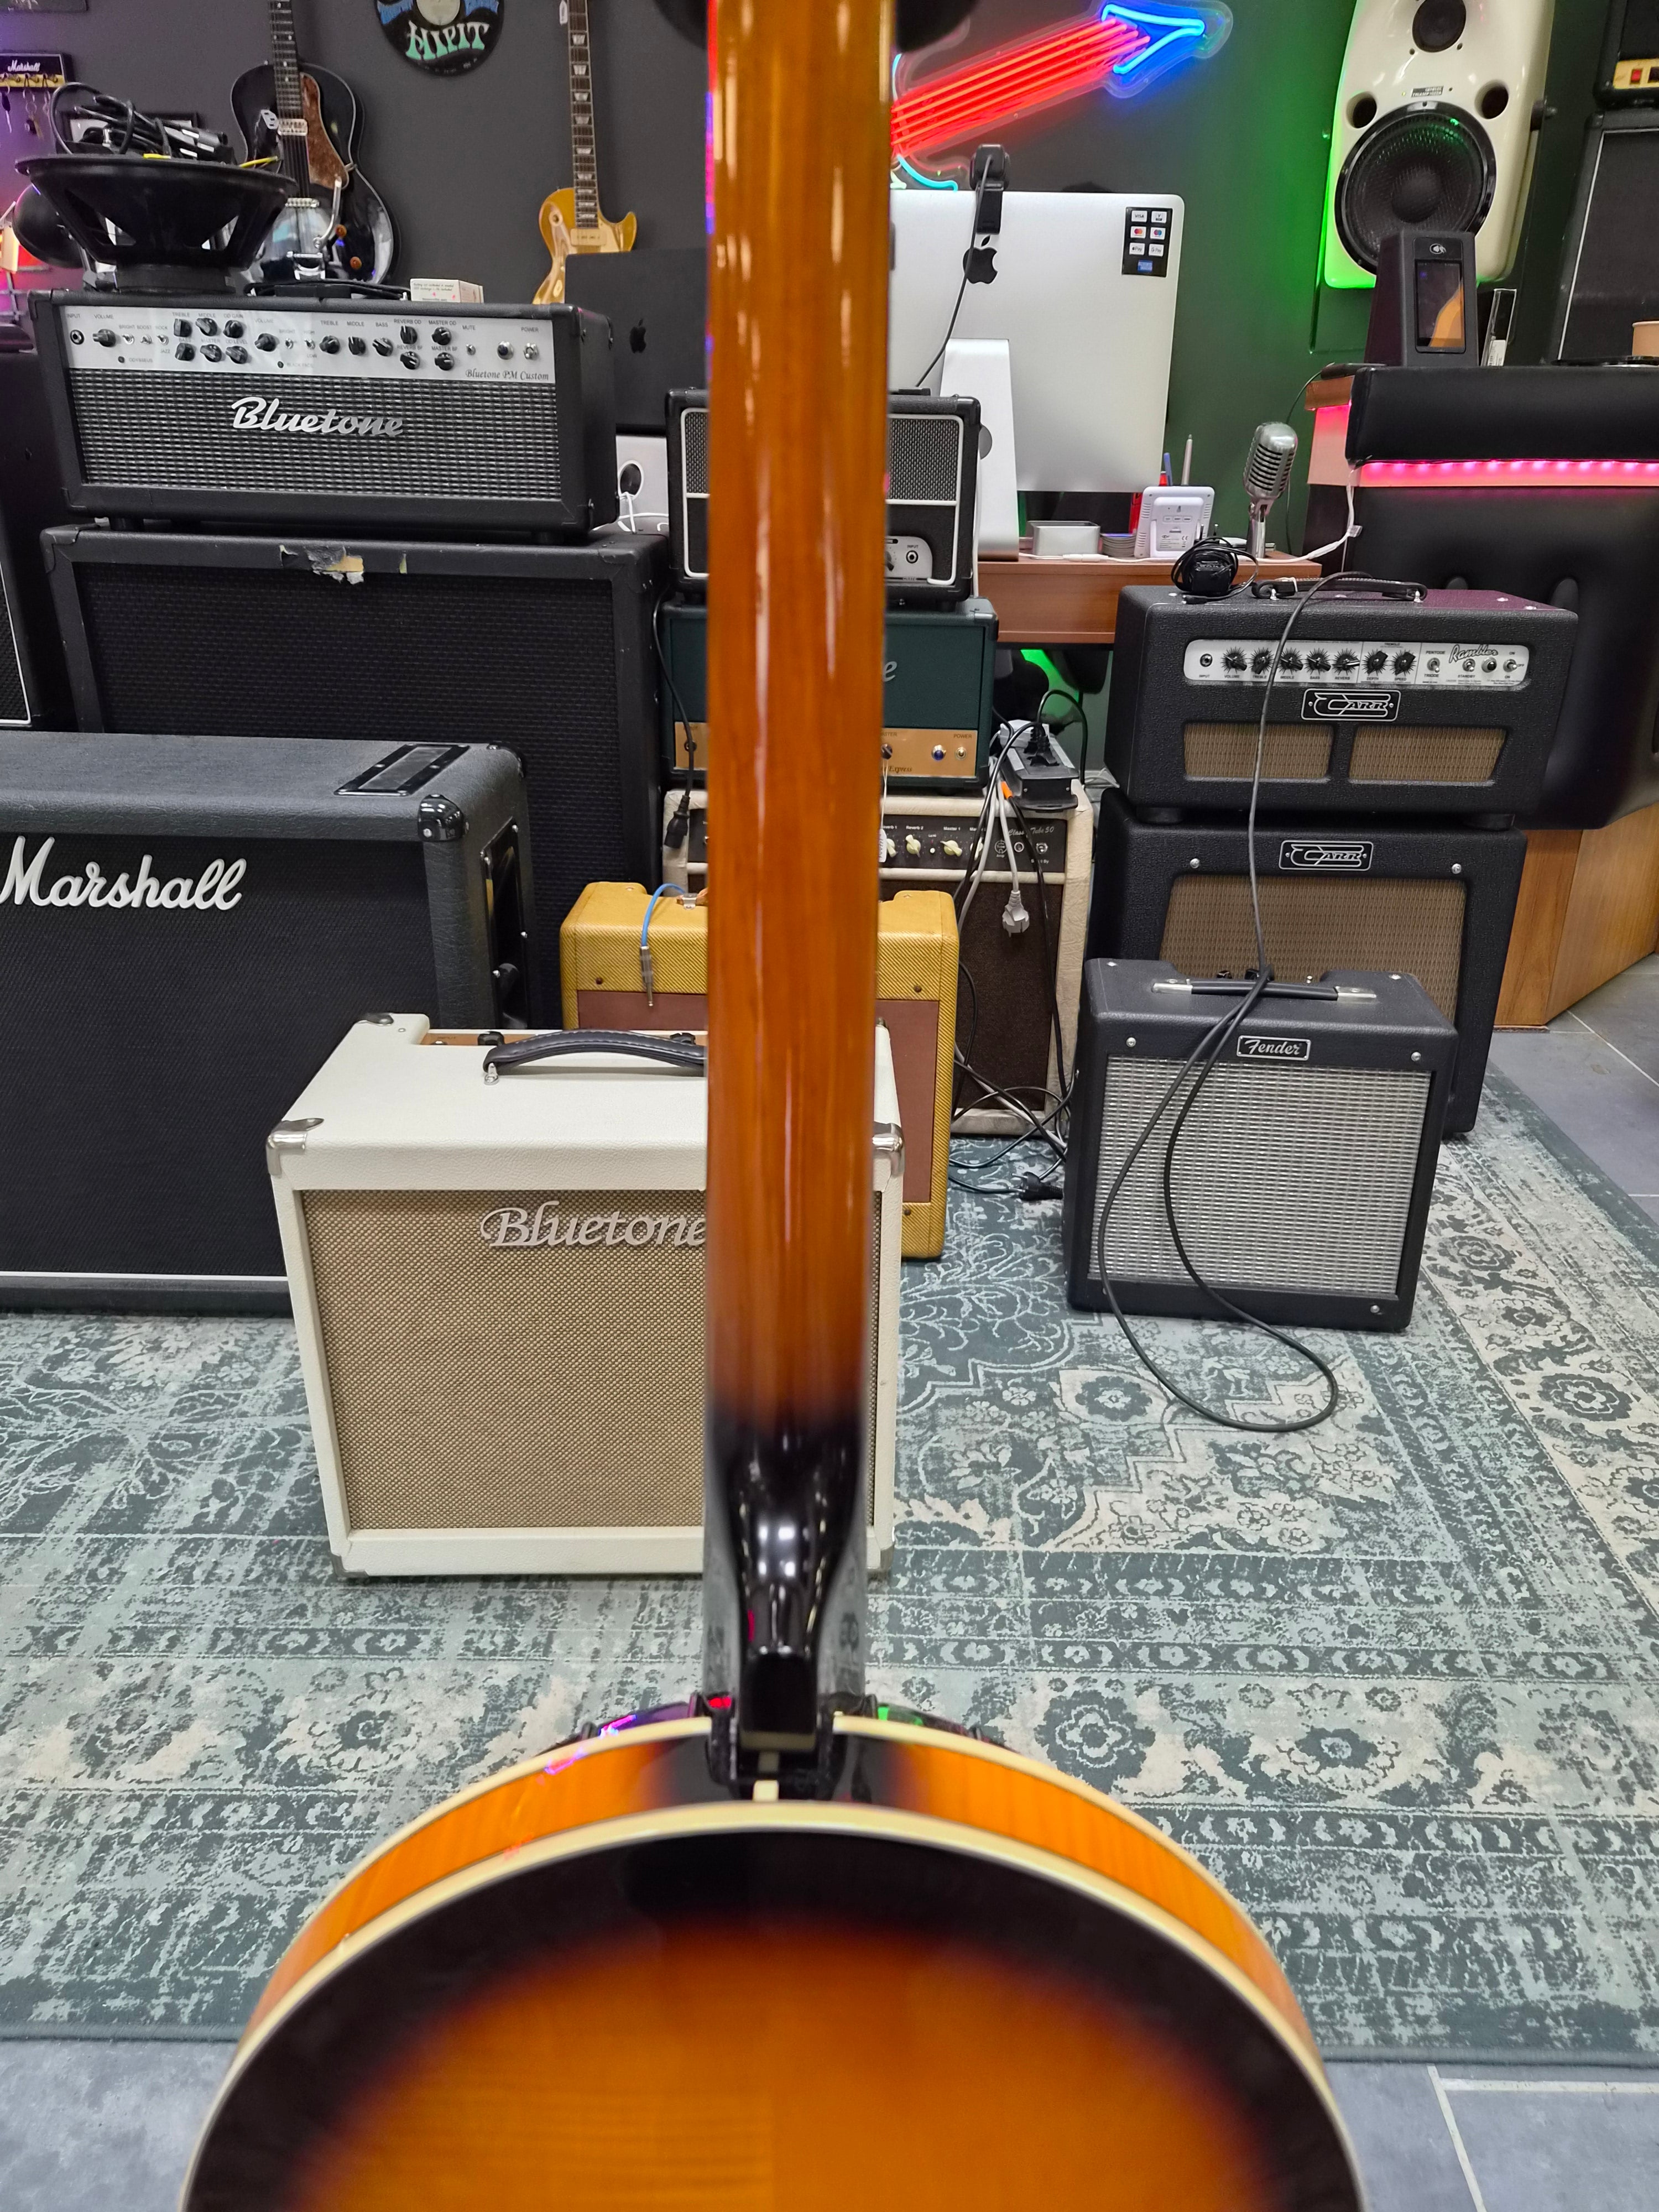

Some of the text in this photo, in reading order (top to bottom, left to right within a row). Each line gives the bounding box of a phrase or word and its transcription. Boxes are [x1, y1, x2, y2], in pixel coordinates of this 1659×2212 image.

[8, 59, 41, 72] Marshall
[466, 368, 550, 380] Bluetone PM Custom
[231, 396, 404, 437] Bluetone
[1448, 644, 1499, 664] Rambler
[1313, 692, 1391, 717] CARR
[889, 765, 912, 774] Express
[1290, 843, 1364, 867] CARR
[0, 836, 247, 910] Marshall
[1244, 1039, 1300, 1055] Fender
[480, 1200, 707, 1247] Bluetone
